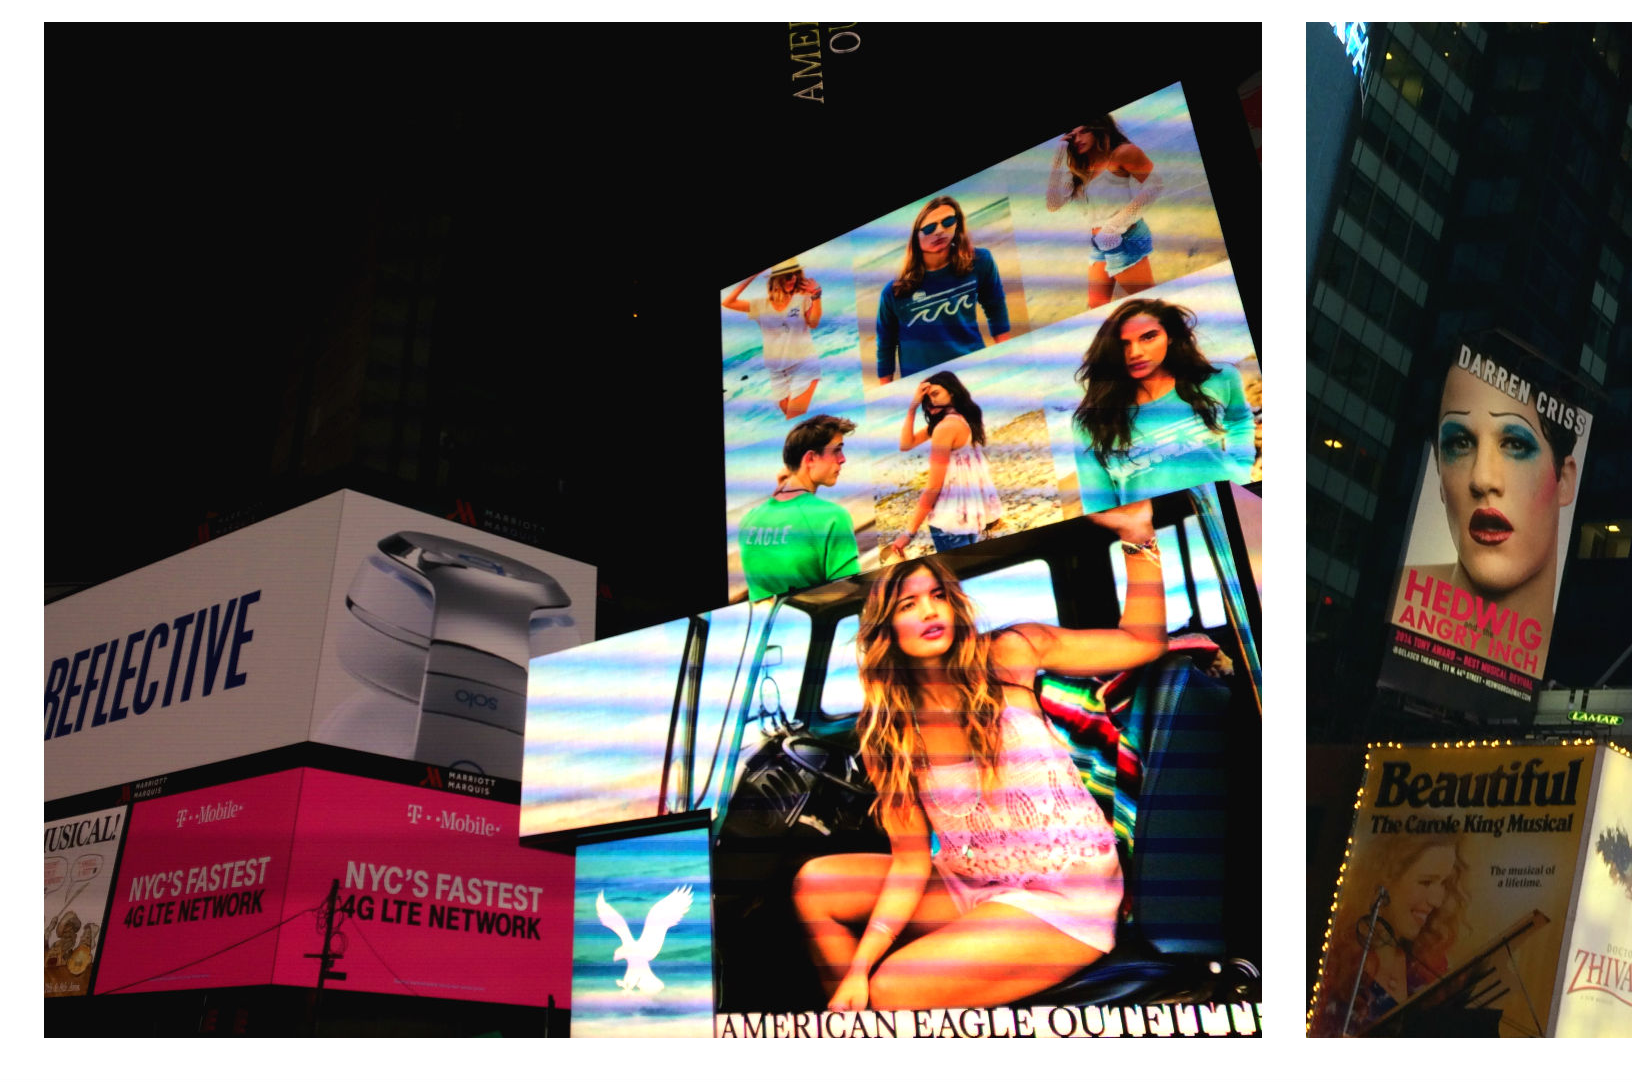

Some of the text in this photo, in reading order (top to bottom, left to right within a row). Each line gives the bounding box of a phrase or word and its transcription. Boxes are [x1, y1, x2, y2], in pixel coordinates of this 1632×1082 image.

[1458, 344, 1588, 437] DARREN CRISS
[745, 523, 792, 547] EAGLE
[1404, 568, 1543, 651] HEDWIG
[1399, 604, 1539, 674] ANGRY INCH
[44, 589, 262, 741] REFLECTIVE
[1413, 635, 1432, 652] TONY
[1432, 641, 1456, 661] AWARD
[1463, 654, 1481, 670] BEST
[1481, 660, 1508, 681] MUSICAL
[1508, 671, 1534, 691] REVIVAL
[1572, 710, 1620, 726] LAMAR
[133, 787, 163, 799] MARQUIS
[134, 776, 169, 791] MARRIOTT
[448, 780, 491, 796] MARQUIS
[449, 771, 497, 787] MARRIOTT
[1373, 757, 1585, 809] Beautiful
[1371, 813, 1573, 837] The Carole King Musical
[128, 856, 272, 903] NYC'S FASTEST
[345, 860, 544, 914] NYC'S FASTEST
[1490, 865, 1556, 876] The musical of
[124, 888, 266, 930] 4G LTE NETWORK
[340, 894, 542, 941] 4G LTE NETWORK
[719, 1007, 1036, 1038] AMERICAN EAGLE
